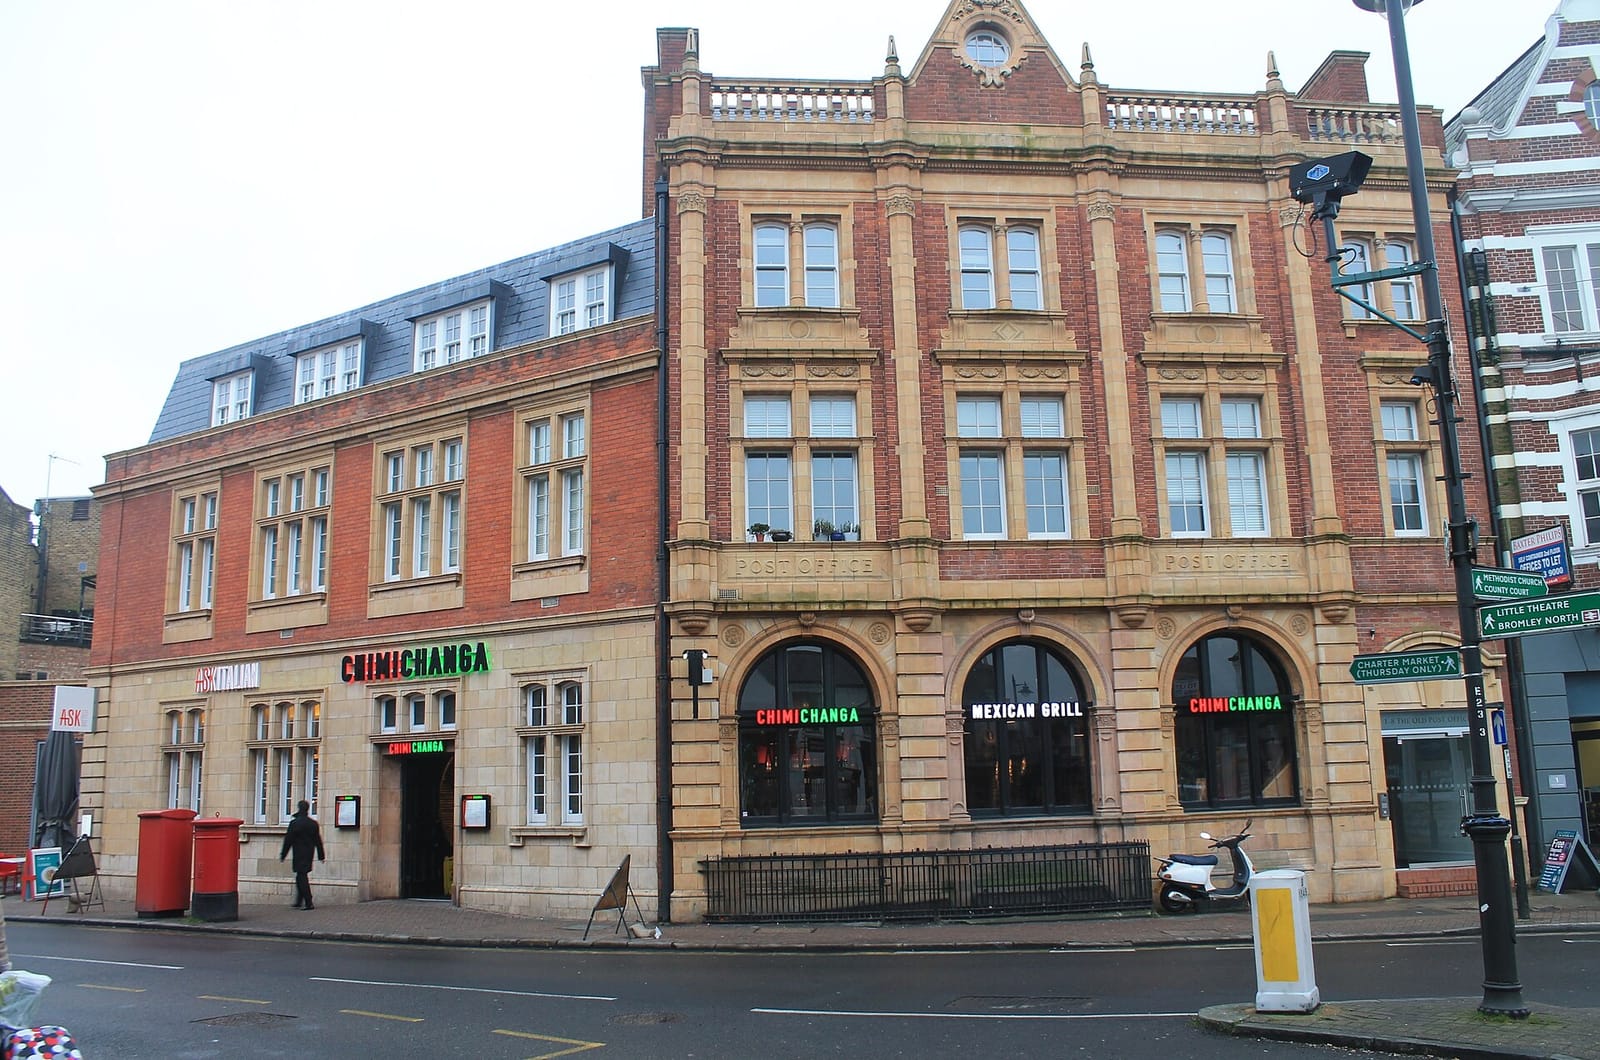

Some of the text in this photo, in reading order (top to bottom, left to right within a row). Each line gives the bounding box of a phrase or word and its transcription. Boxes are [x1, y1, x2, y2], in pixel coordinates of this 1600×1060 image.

[736, 558, 873, 575] POST OFFICE
[1165, 554, 1290, 570] POST OFFICE
[1542, 558, 1550, 568] TO
[1551, 555, 1561, 566] LET
[1548, 566, 1564, 577] 9000
[1483, 573, 1517, 584] METHODIST
[1518, 575, 1543, 586] CHURCH
[1485, 584, 1529, 596] COUNTY COURT
[1496, 600, 1570, 617] LITTLE THEATRE
[1498, 613, 1579, 630] BROMLEY NORTH
[341, 641, 491, 683] CHIMICHANGA
[1357, 655, 1440, 670] CHARTER MARKET
[1356, 664, 1442, 678] (THURSDAY ONLY)
[972, 701, 1083, 719] MEXICAN GRILL
[1190, 695, 1282, 713] CHIMICHANGA
[60, 708, 81, 727] ASK
[756, 707, 859, 725] CHIMICHANGA
[1397, 717, 1410, 725] THE
[1412, 716, 1427, 724] OLD
[1428, 715, 1445, 724] POST
[1447, 714, 1467, 723] OFFIC
[388, 740, 444, 755] CHIMICHANGA
[1552, 838, 1565, 849] Free
